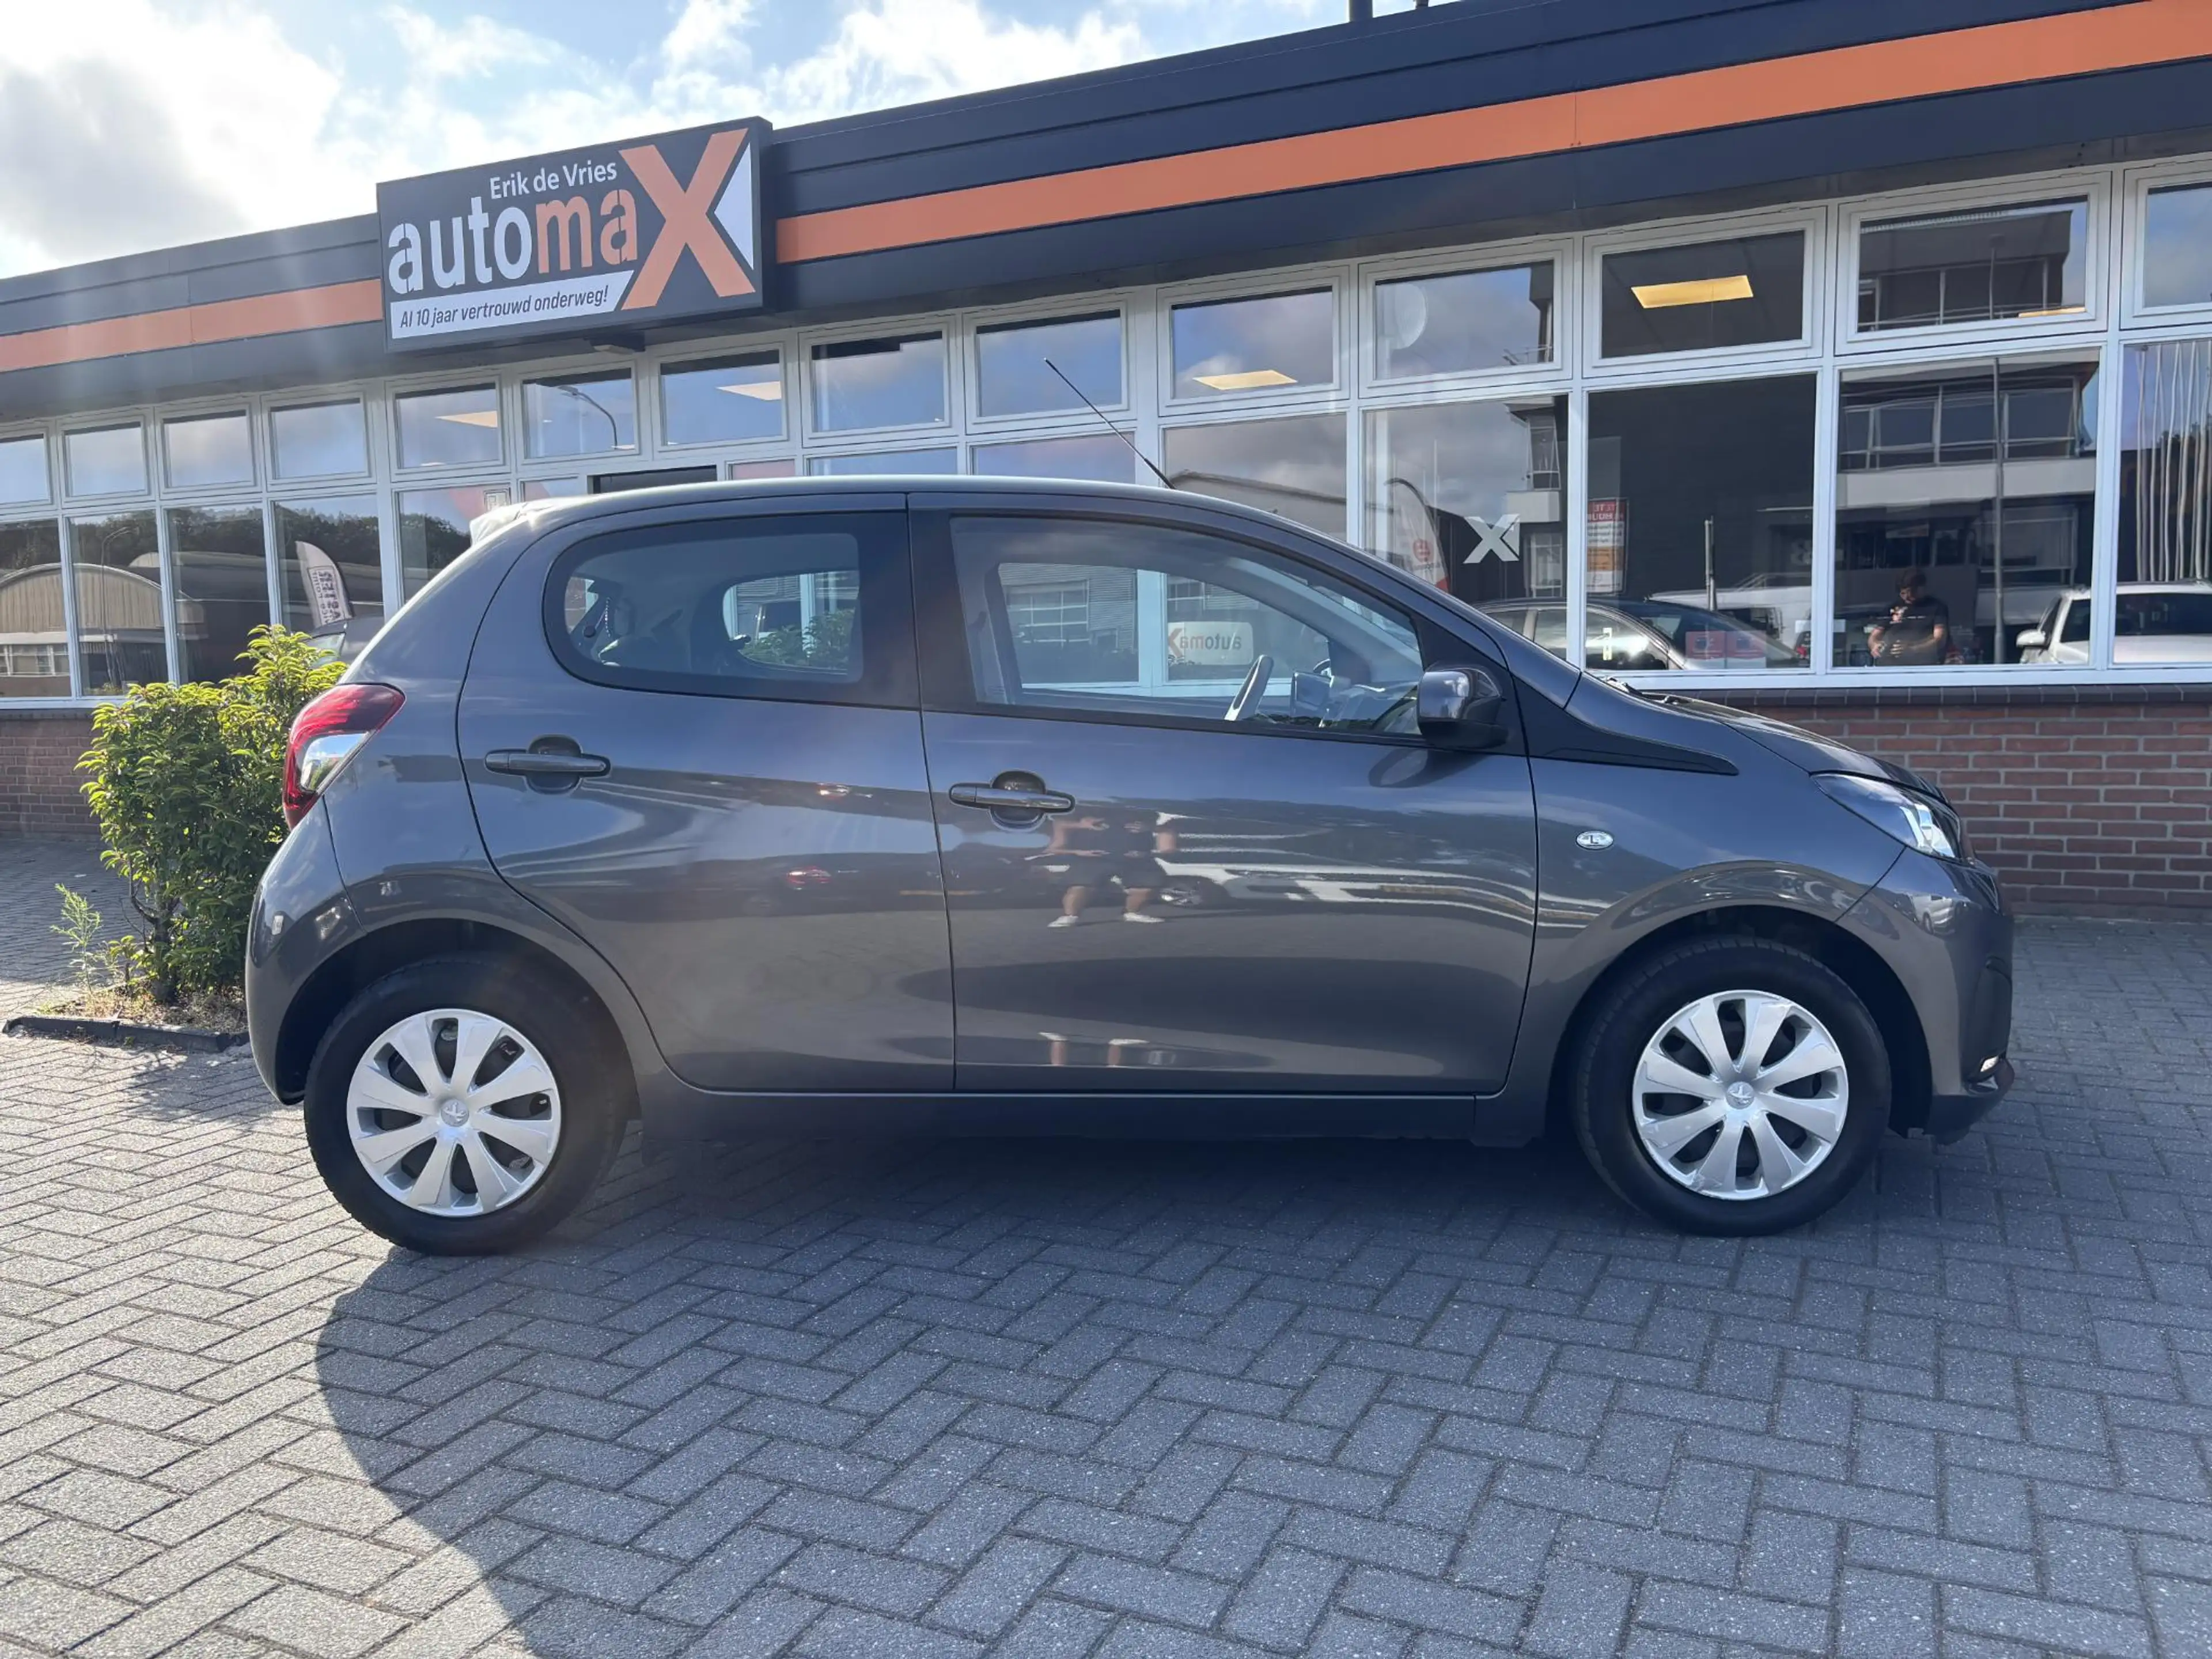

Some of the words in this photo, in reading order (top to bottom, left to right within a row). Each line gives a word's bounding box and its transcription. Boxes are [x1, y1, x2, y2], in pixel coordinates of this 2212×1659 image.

[490, 171, 530, 199] Erik
[533, 167, 560, 192] de
[562, 160, 618, 187] Vries
[400, 310, 413, 328] Al
[416, 308, 430, 326] 10
[430, 307, 459, 328] jaar
[461, 295, 532, 321] vertrouwd
[534, 285, 609, 311] onderweg!
